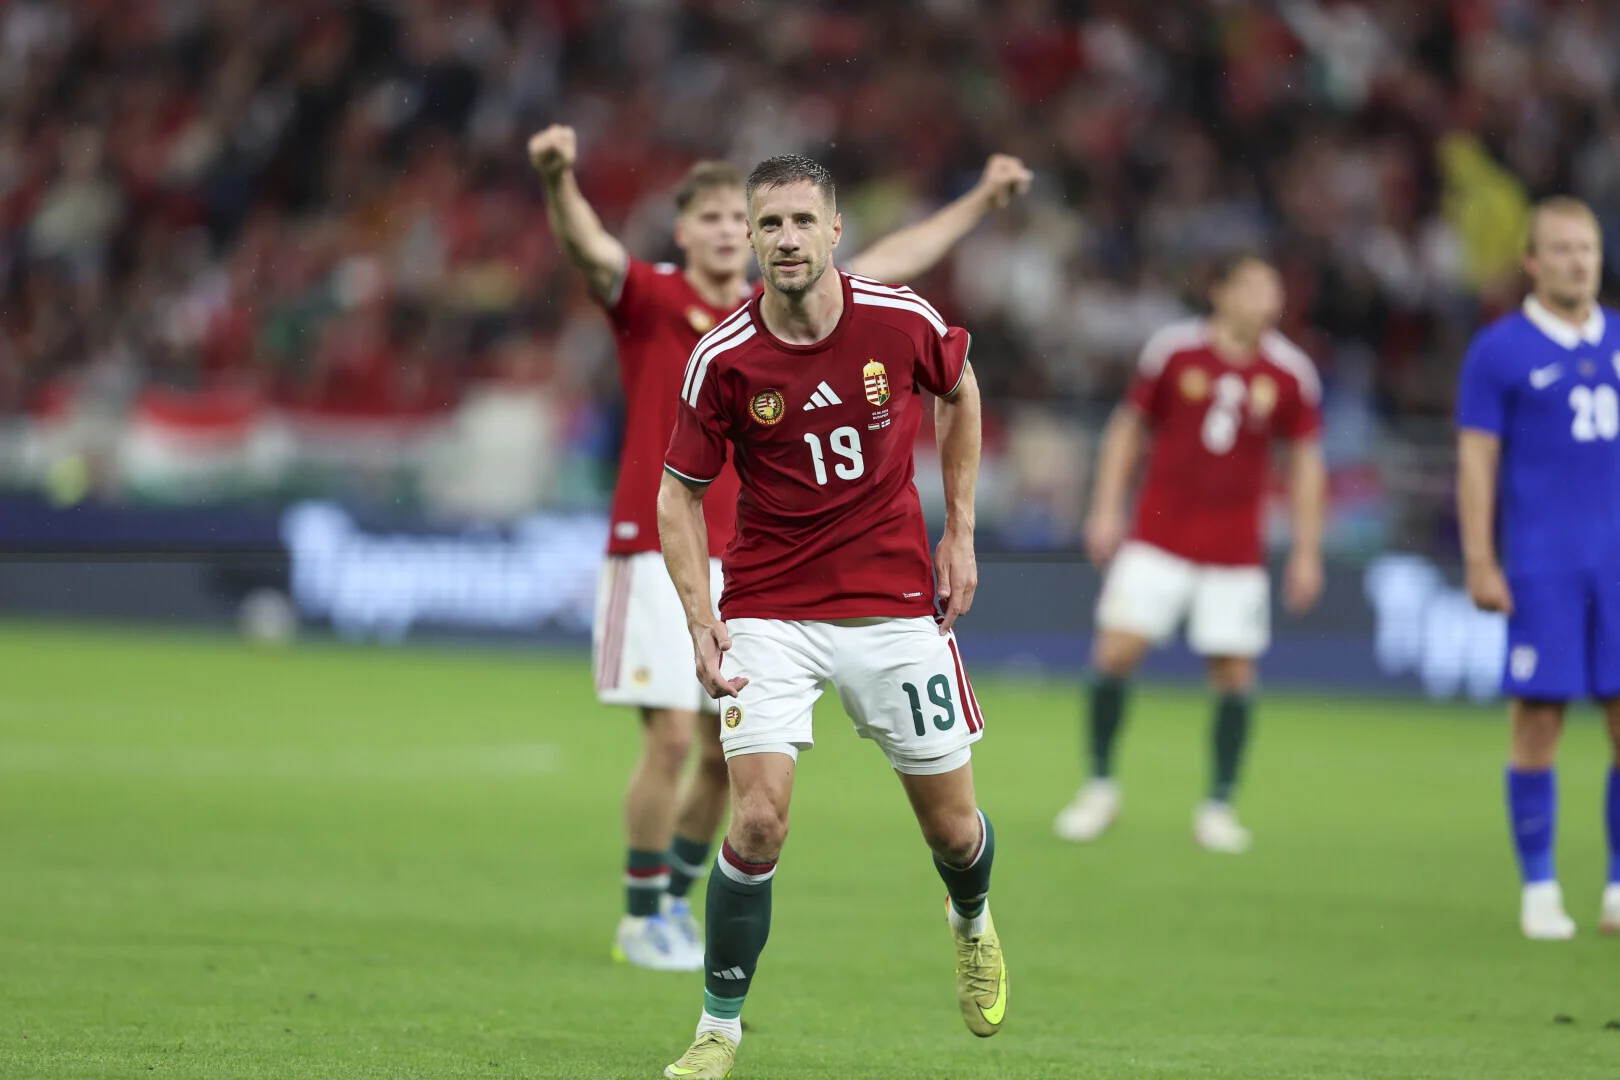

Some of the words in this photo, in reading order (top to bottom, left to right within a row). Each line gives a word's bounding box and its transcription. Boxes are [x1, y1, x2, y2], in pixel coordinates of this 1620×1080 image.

[1569, 383, 1619, 443] 20
[803, 426, 864, 486] 19
[902, 673, 955, 737] 19
